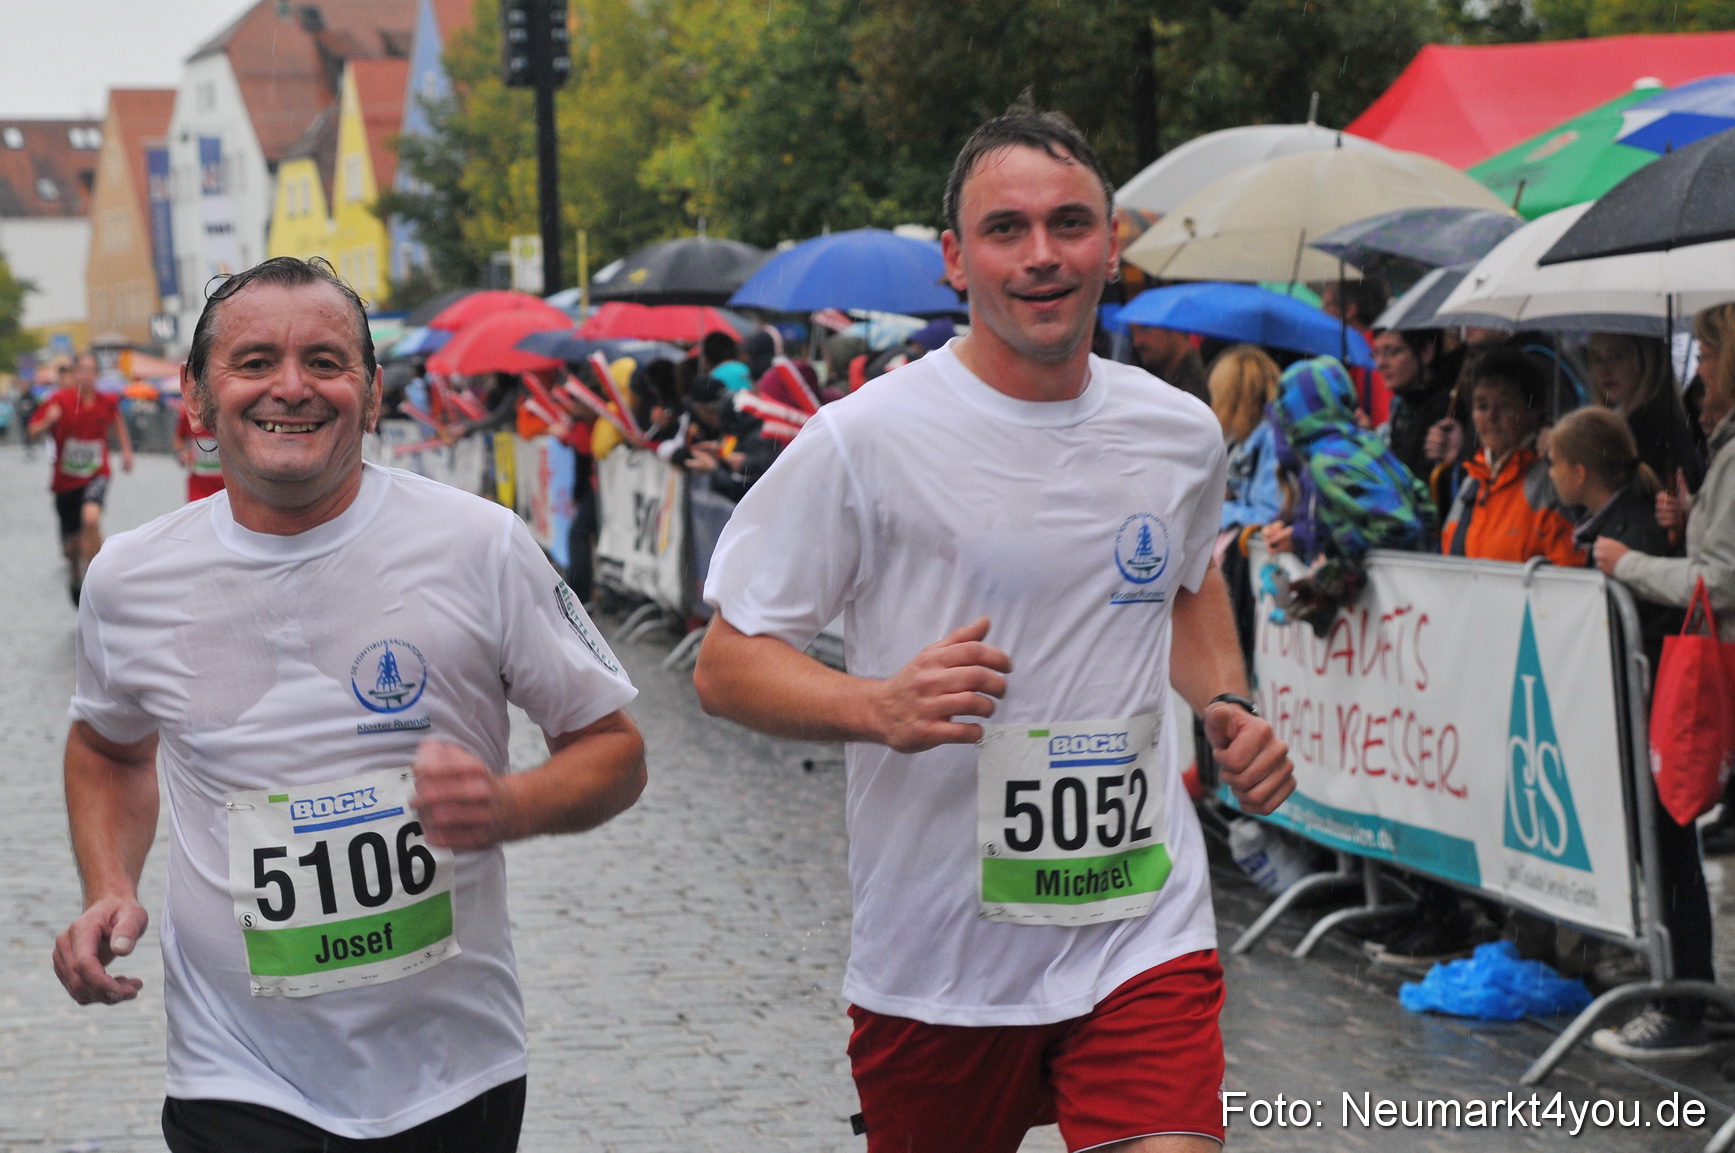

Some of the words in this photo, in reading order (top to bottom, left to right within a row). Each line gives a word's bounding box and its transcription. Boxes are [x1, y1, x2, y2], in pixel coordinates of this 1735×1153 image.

[357, 722, 391, 731] Kloster
[1049, 732, 1129, 755] BOCK
[290, 787, 378, 820] BOCK
[1003, 768, 1152, 852] 5052
[253, 821, 437, 921] 5106
[1035, 860, 1133, 897] Michael
[315, 922, 394, 964] Josef
